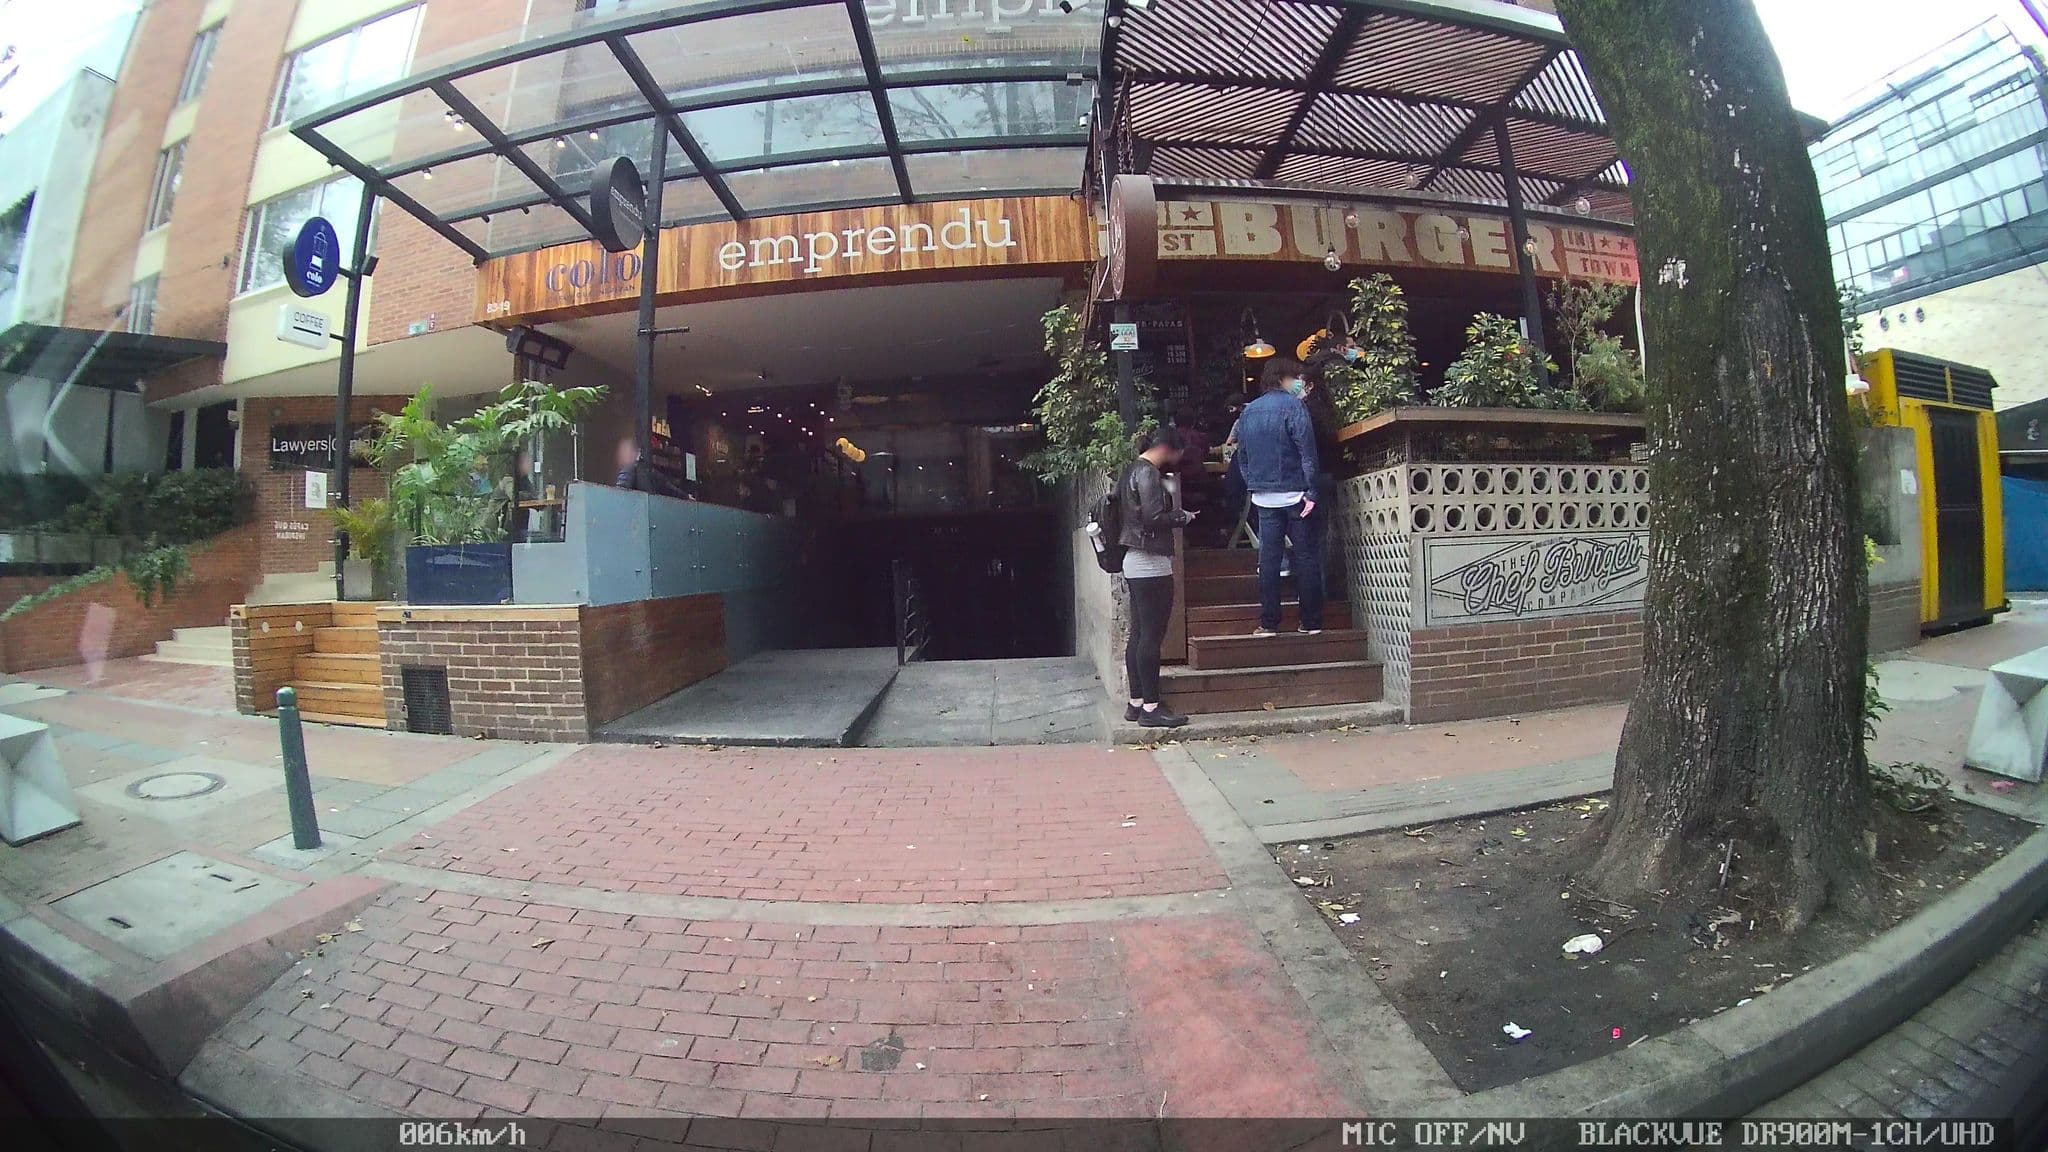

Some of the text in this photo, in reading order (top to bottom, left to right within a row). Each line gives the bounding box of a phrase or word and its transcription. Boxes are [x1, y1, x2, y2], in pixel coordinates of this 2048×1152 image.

[718, 207, 1017, 273] emprendu
[1163, 233, 1195, 251] ST
[1221, 202, 1560, 273] BURGER
[545, 250, 642, 292] colo
[1579, 257, 1632, 278] TOWN
[294, 311, 324, 328] COFFEE
[272, 438, 328, 455] Lawyers
[1461, 533, 1642, 616] Chef Burger
[1501, 555, 1526, 573] THE
[1527, 582, 1597, 611] COMPANY
